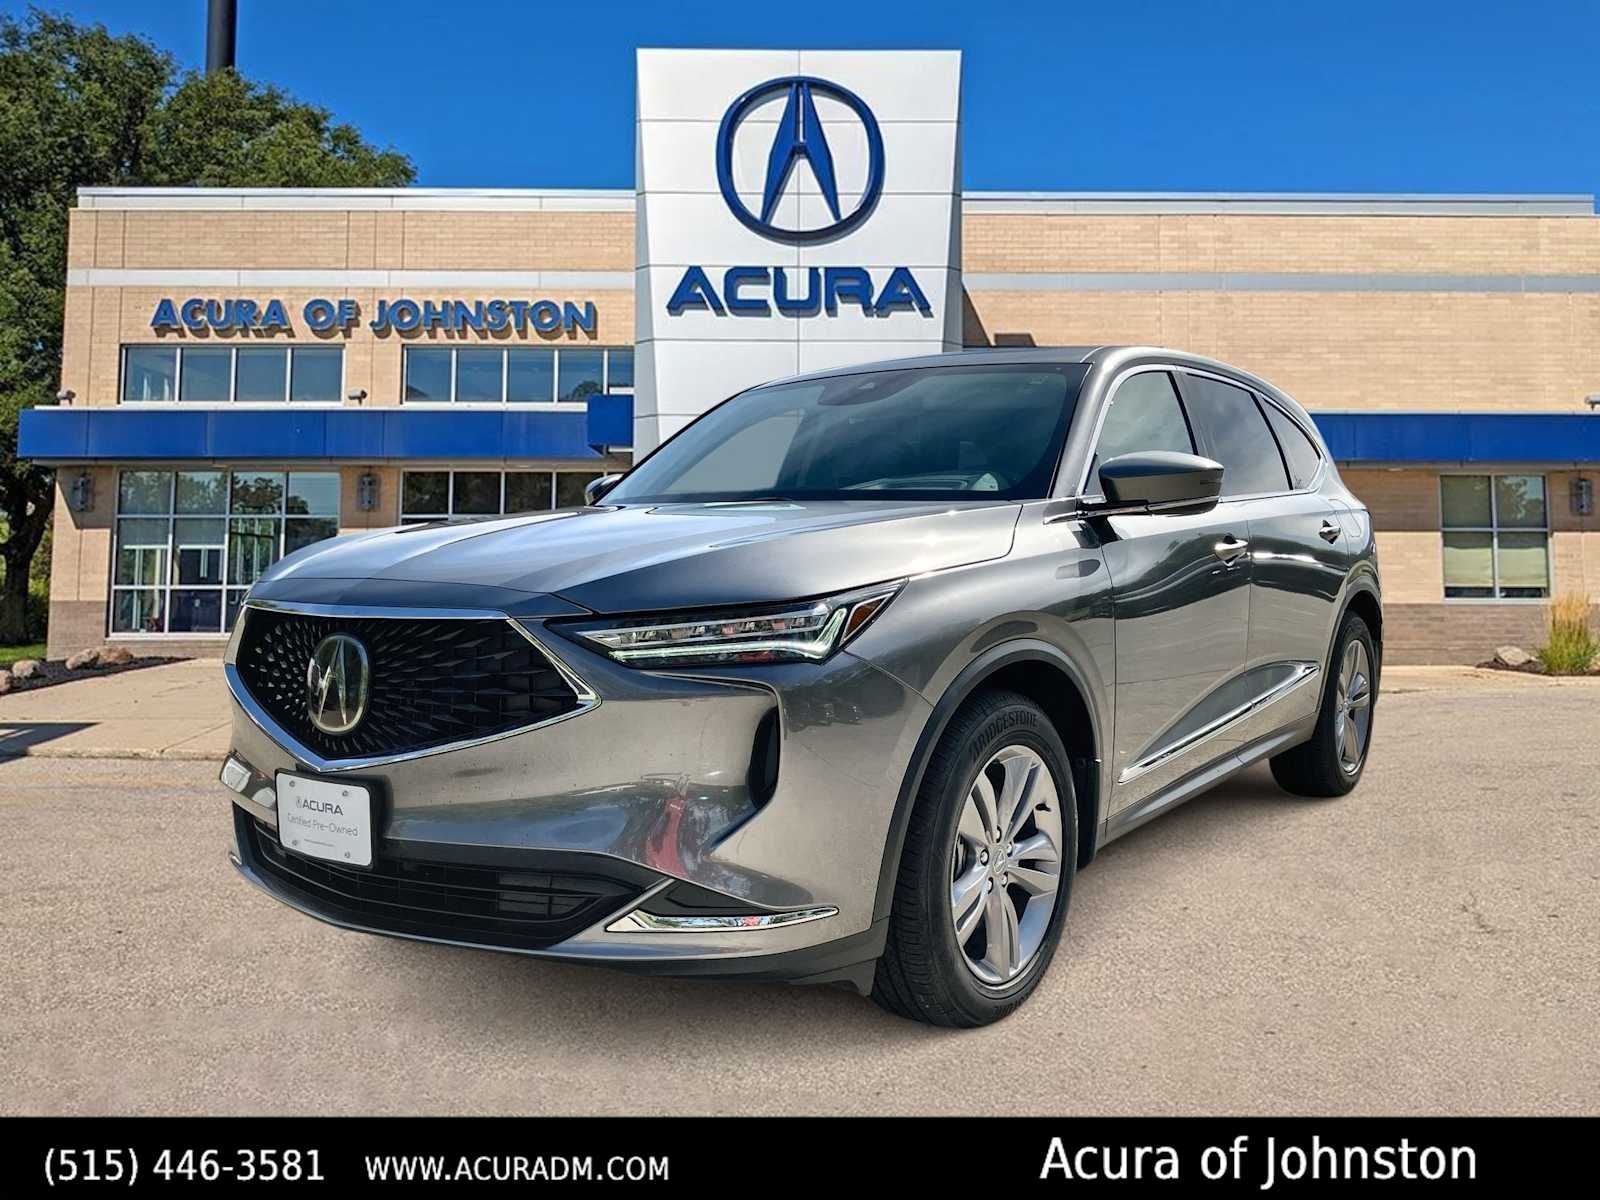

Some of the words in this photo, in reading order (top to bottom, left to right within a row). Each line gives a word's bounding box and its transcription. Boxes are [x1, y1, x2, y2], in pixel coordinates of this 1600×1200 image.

[666, 265, 934, 317] ACURA
[151, 298, 292, 330] ACURA
[303, 298, 358, 330] OF
[369, 299, 595, 332] JOHNSTON
[968, 710, 1039, 763] BRIDGESTONE
[302, 799, 344, 816] ACURA
[313, 820, 359, 837] Pre-Owned
